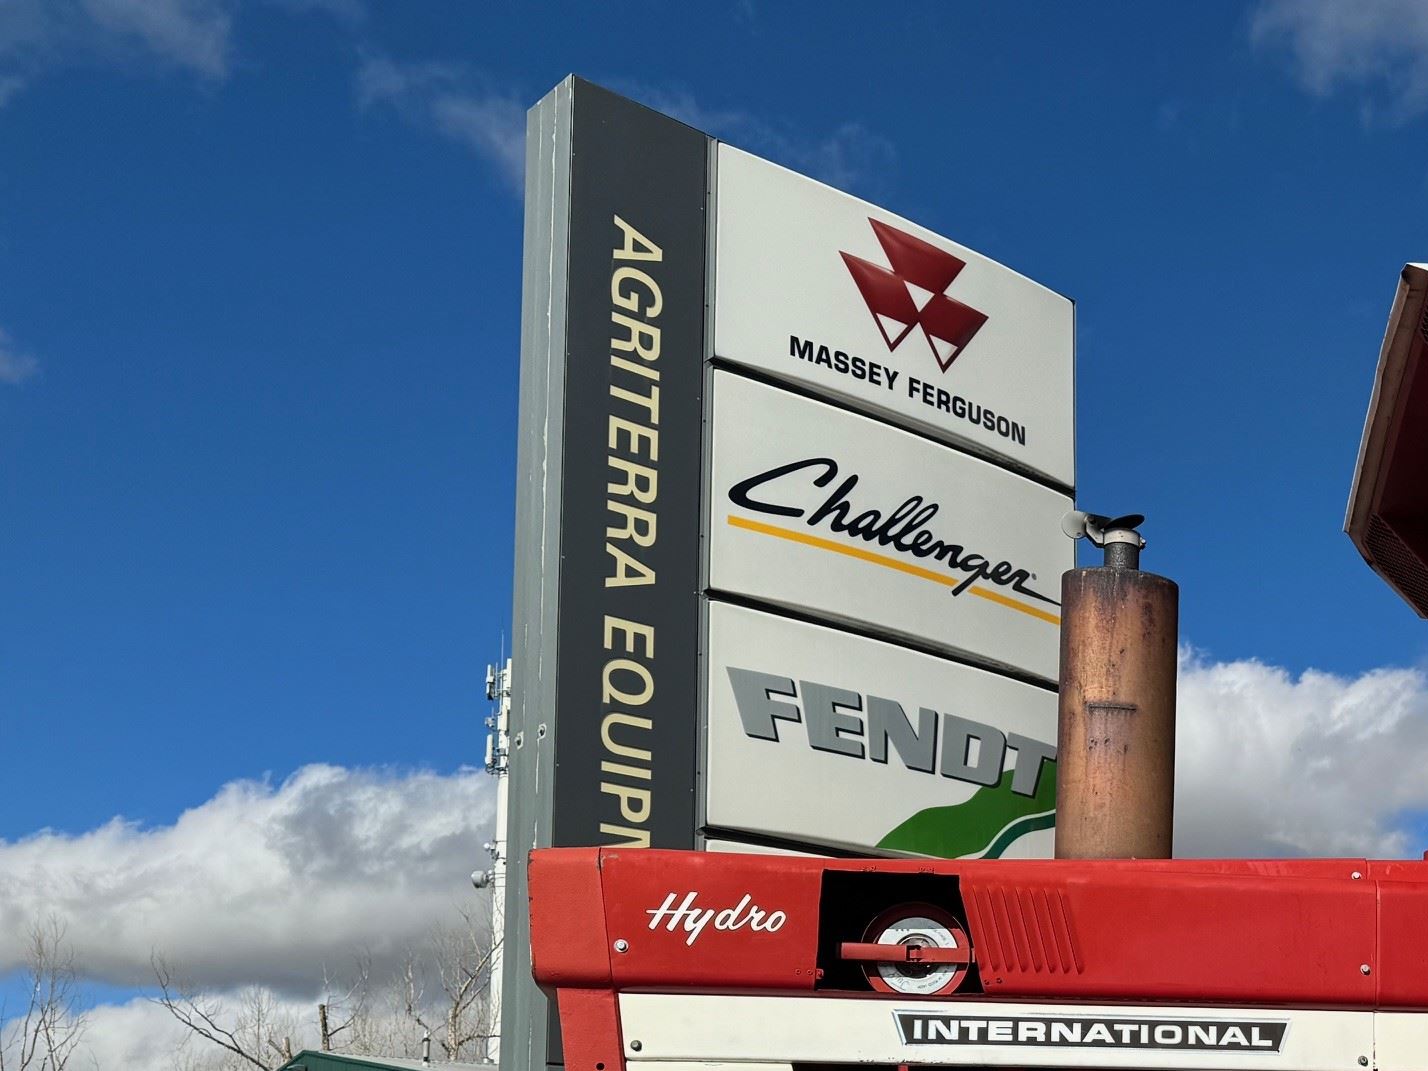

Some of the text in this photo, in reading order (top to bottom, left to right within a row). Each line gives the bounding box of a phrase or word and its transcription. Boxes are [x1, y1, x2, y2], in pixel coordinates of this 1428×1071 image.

[604, 214, 664, 588] AGRITERRA
[789, 335, 1026, 446] MASSEY FERGUSON
[728, 457, 1062, 606] Challenger
[726, 666, 1057, 799] FENDT
[645, 891, 787, 947] Hydro
[912, 1018, 1274, 1048] INTERNATIONAL
